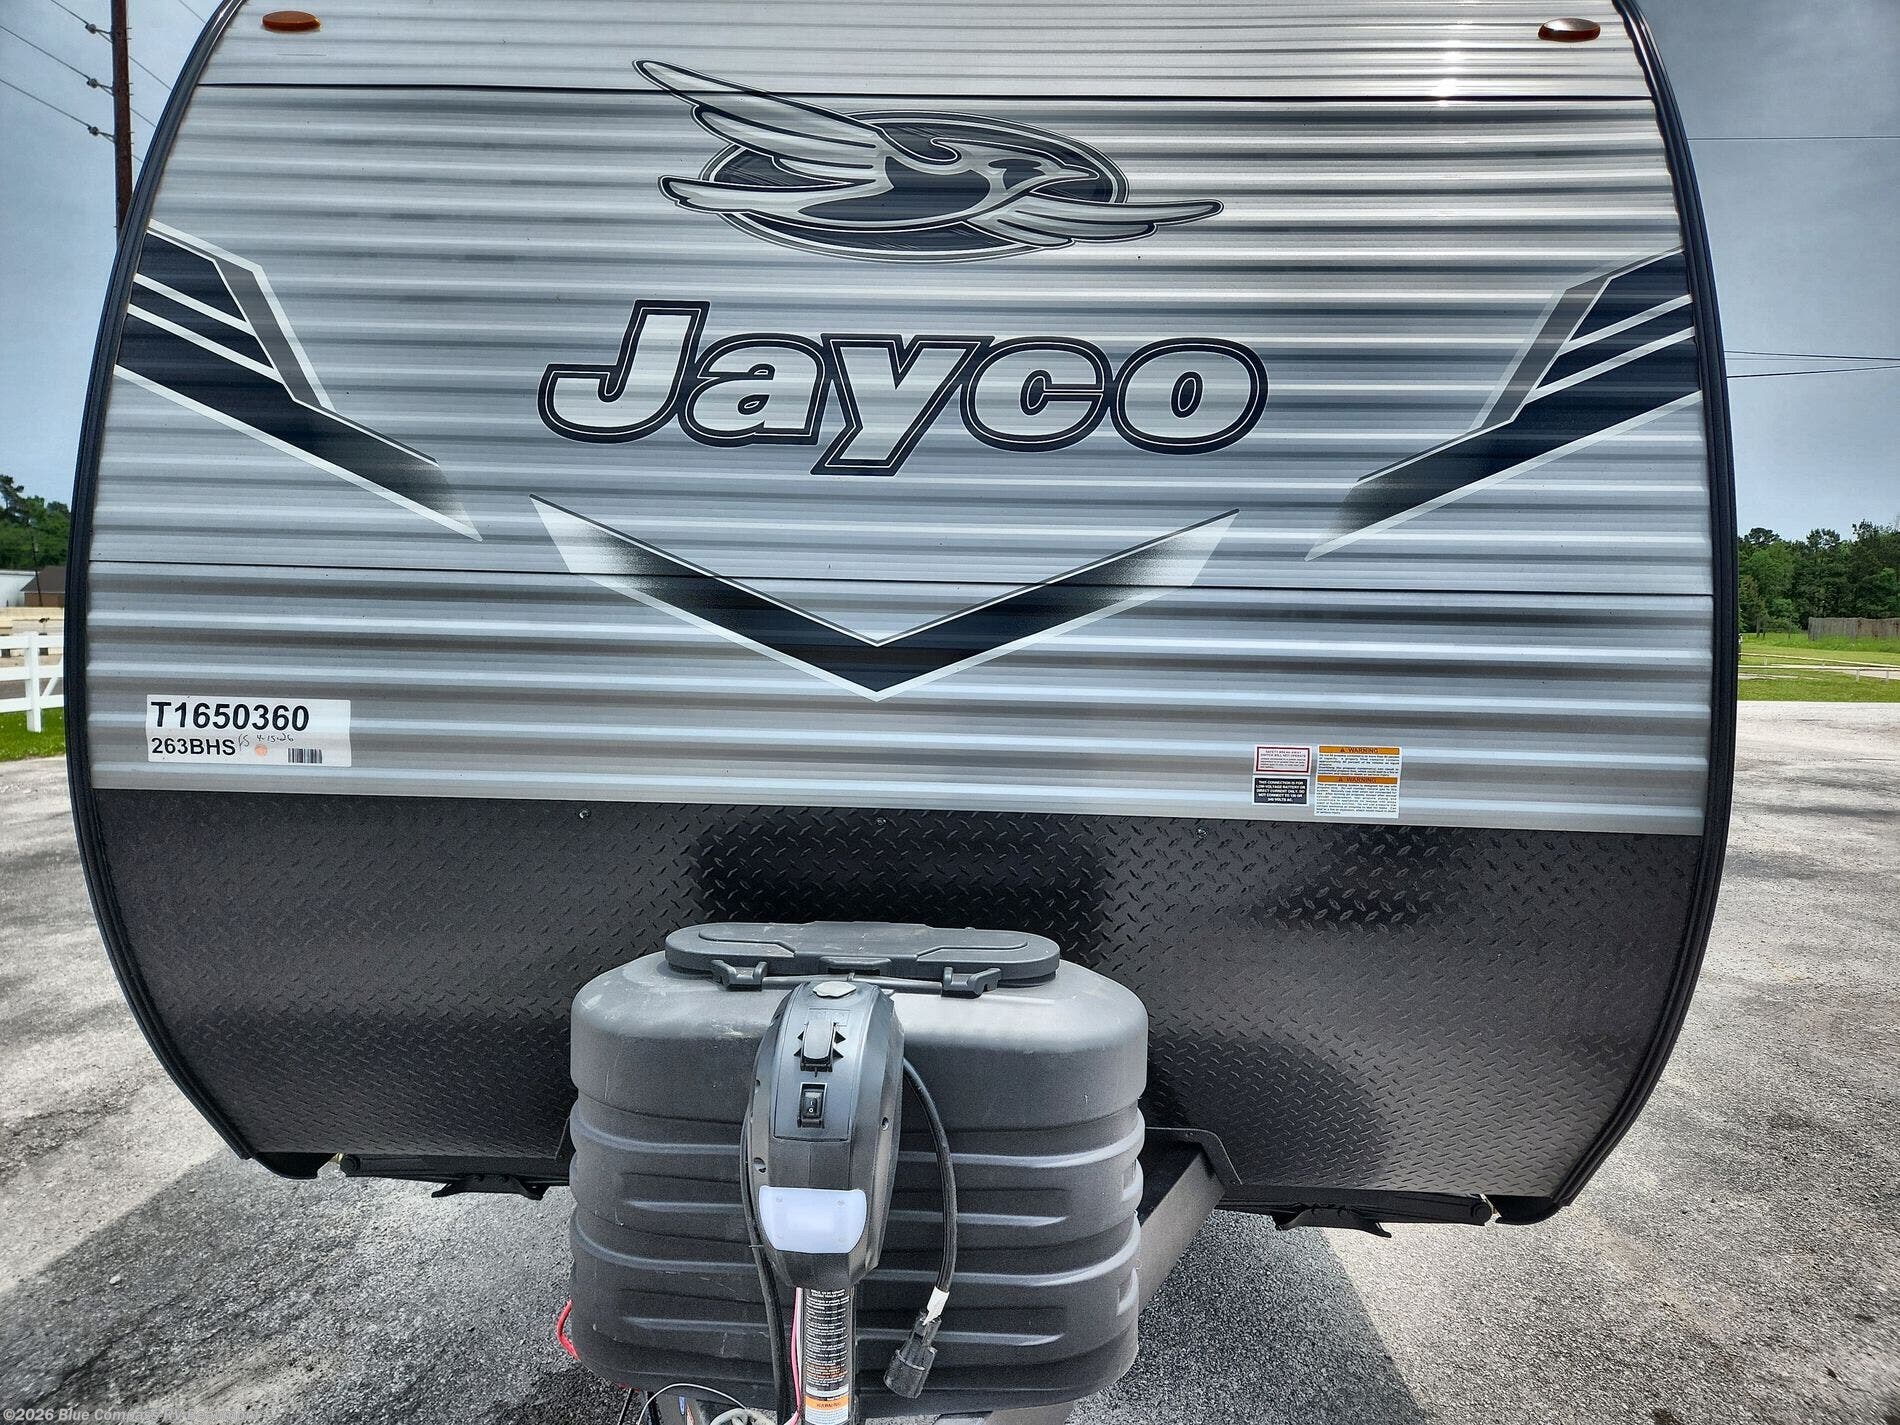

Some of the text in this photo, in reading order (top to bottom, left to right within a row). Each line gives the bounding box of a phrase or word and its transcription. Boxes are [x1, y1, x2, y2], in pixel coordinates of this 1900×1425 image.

[538, 299, 1268, 476] Jayco
[151, 701, 309, 731] T1650360
[151, 737, 236, 756] 263BHS
[1347, 776, 1377, 784] WARNING
